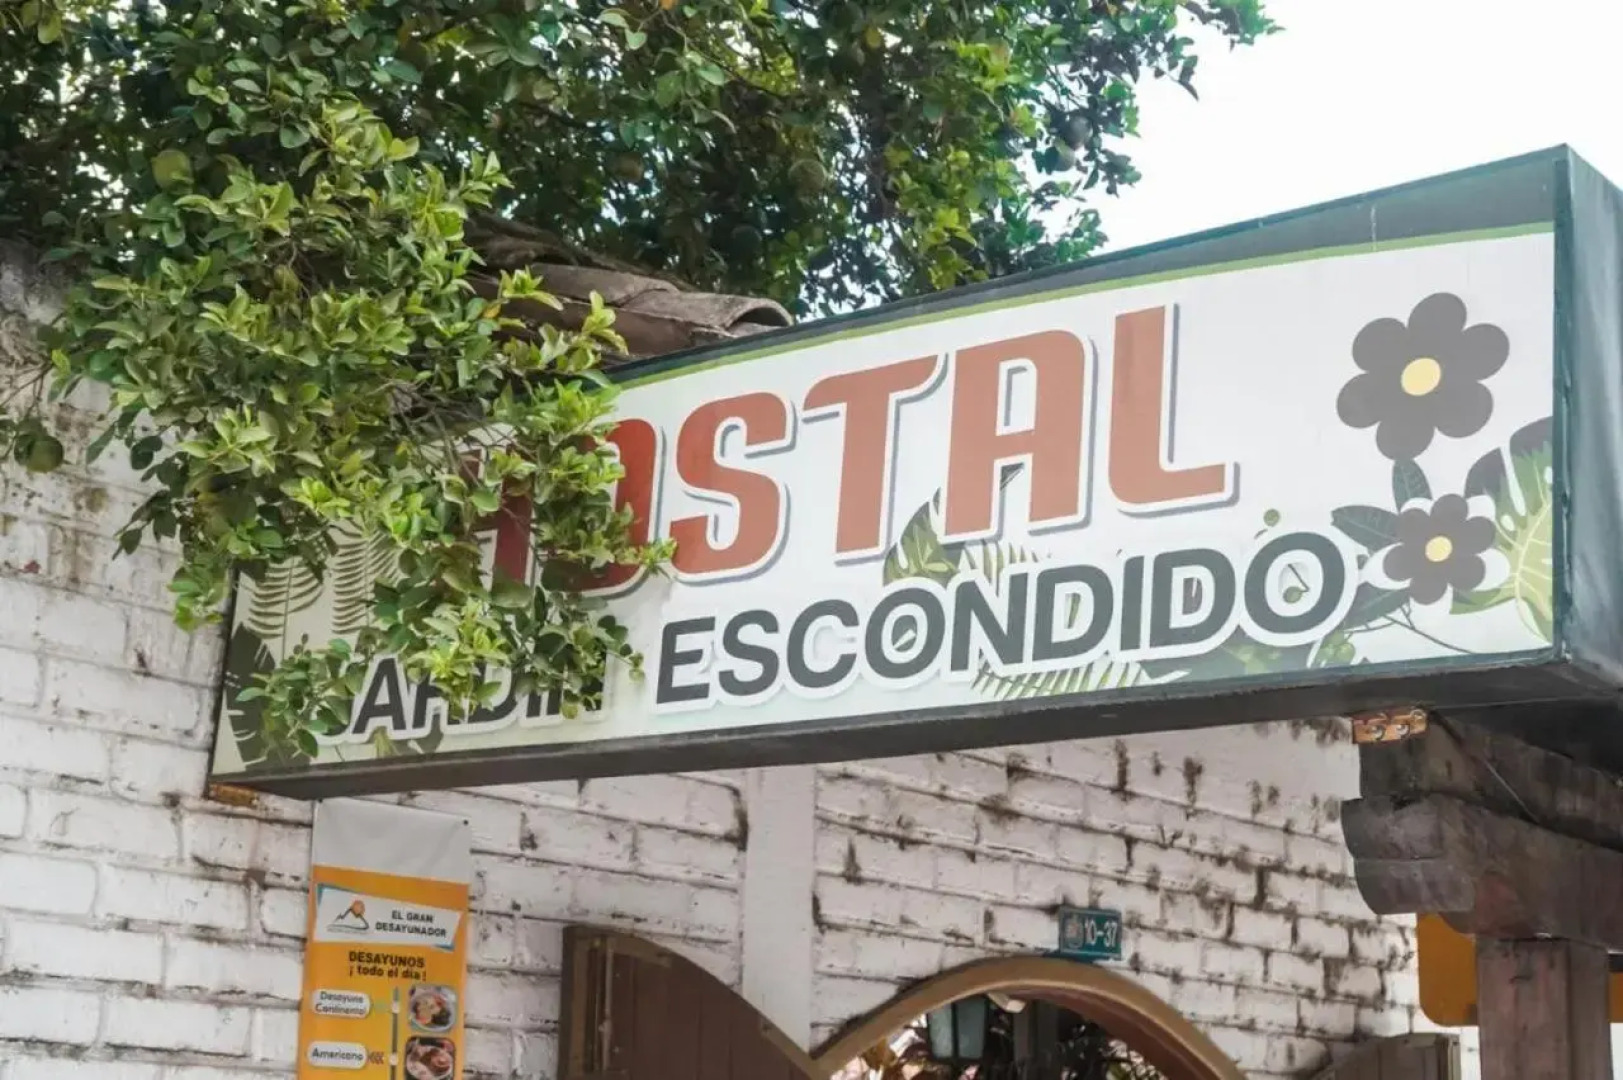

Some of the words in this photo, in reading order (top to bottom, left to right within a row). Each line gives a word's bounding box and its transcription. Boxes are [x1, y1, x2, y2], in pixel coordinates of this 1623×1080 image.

[656, 532, 1346, 704] ESCONDIDO
[392, 910, 403, 920] EL
[407, 912, 433, 923] GRAN
[375, 922, 446, 938] DESAYUNADOR
[349, 951, 425, 968] DESAYUNOS
[358, 965, 384, 977] todo
[387, 967, 399, 978] el
[312, 1047, 364, 1061] Americano
